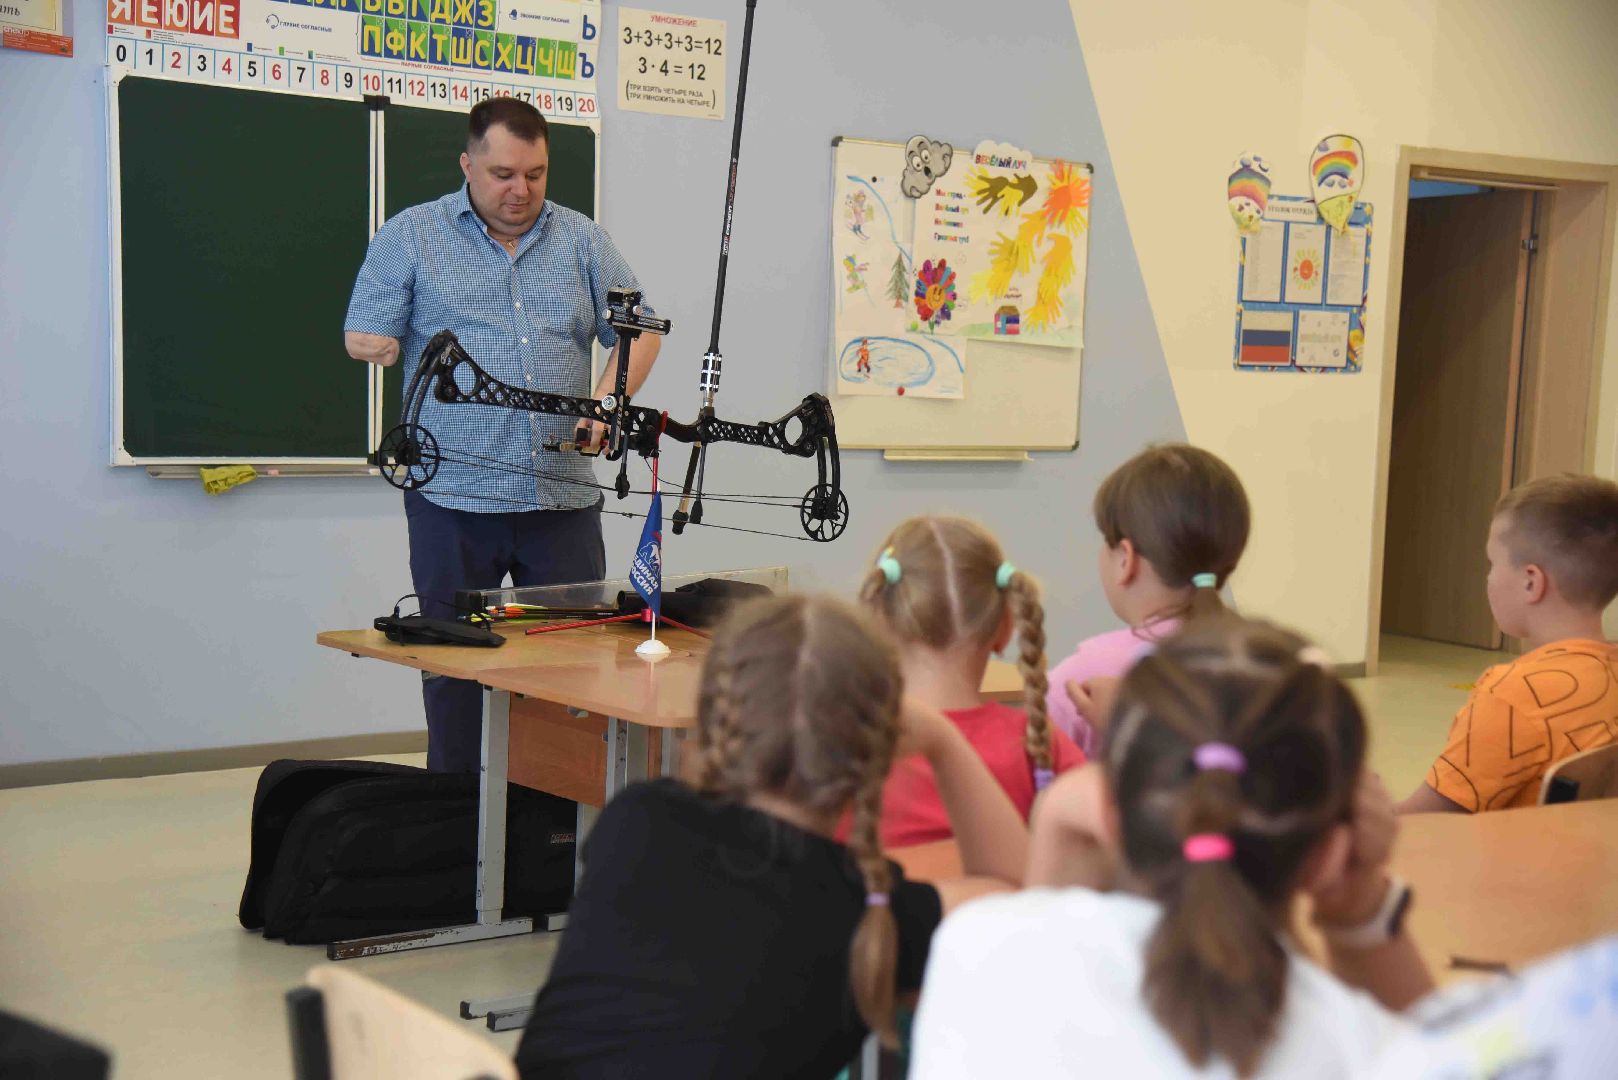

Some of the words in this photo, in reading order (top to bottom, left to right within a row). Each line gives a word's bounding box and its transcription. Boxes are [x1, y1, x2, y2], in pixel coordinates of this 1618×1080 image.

[165, 0, 189, 28] Ю
[193, 0, 214, 32] И
[218, 4, 236, 34] Е
[430, 0, 452, 24] Д
[453, 0, 474, 25] Ж
[477, 0, 494, 27] З
[541, 16, 570, 24] СОГЛАСНЫЕ
[650, 15, 697, 28] УМНОЖЕНИЕ
[280, 21, 300, 29] ГЛУХИЕ
[301, 23, 332, 32] СОГЛАСНЫЕ
[363, 24, 382, 53] П
[385, 28, 405, 56] Ф
[409, 31, 427, 60] К
[432, 34, 448, 62] Т
[451, 36, 472, 65] Ш
[474, 40, 491, 67] С
[495, 42, 513, 70] Х
[516, 44, 534, 75] Ц
[538, 47, 554, 74] Ч
[557, 49, 575, 80] Щ
[623, 26, 722, 56] 3+3+3+3=12
[116, 44, 127, 62] 0
[145, 48, 153, 66] 1
[171, 51, 182, 69] 2
[197, 54, 207, 72] 3
[222, 57, 233, 75] 4
[247, 60, 257, 78] 5
[272, 63, 282, 81] 6
[296, 66, 306, 83] 7
[320, 69, 330, 86] 8
[344, 72, 353, 88] 9
[363, 74, 380, 91] 10
[387, 77, 402, 94] 11
[408, 79, 425, 97] 12
[430, 82, 447, 99] 13
[451, 84, 469, 101] 14
[473, 87, 490, 102] 15
[536, 94, 552, 110] 18
[557, 96, 573, 112] 19
[578, 97, 595, 113] 20
[400, 61, 422, 69] ПАРНЫЕ
[424, 64, 454, 72] СОГЛАСНЫЕ
[638, 56, 647, 74] 3
[659, 59, 669, 76] 4
[688, 62, 706, 80] 12
[642, 85, 662, 93] ВЗЯТЬ
[663, 87, 687, 96] ЧЕТЫРЕ
[688, 89, 703, 98] РАЗА
[642, 94, 676, 103] УМНОЖИТЬ
[630, 565, 654, 596] ОССИЯ
